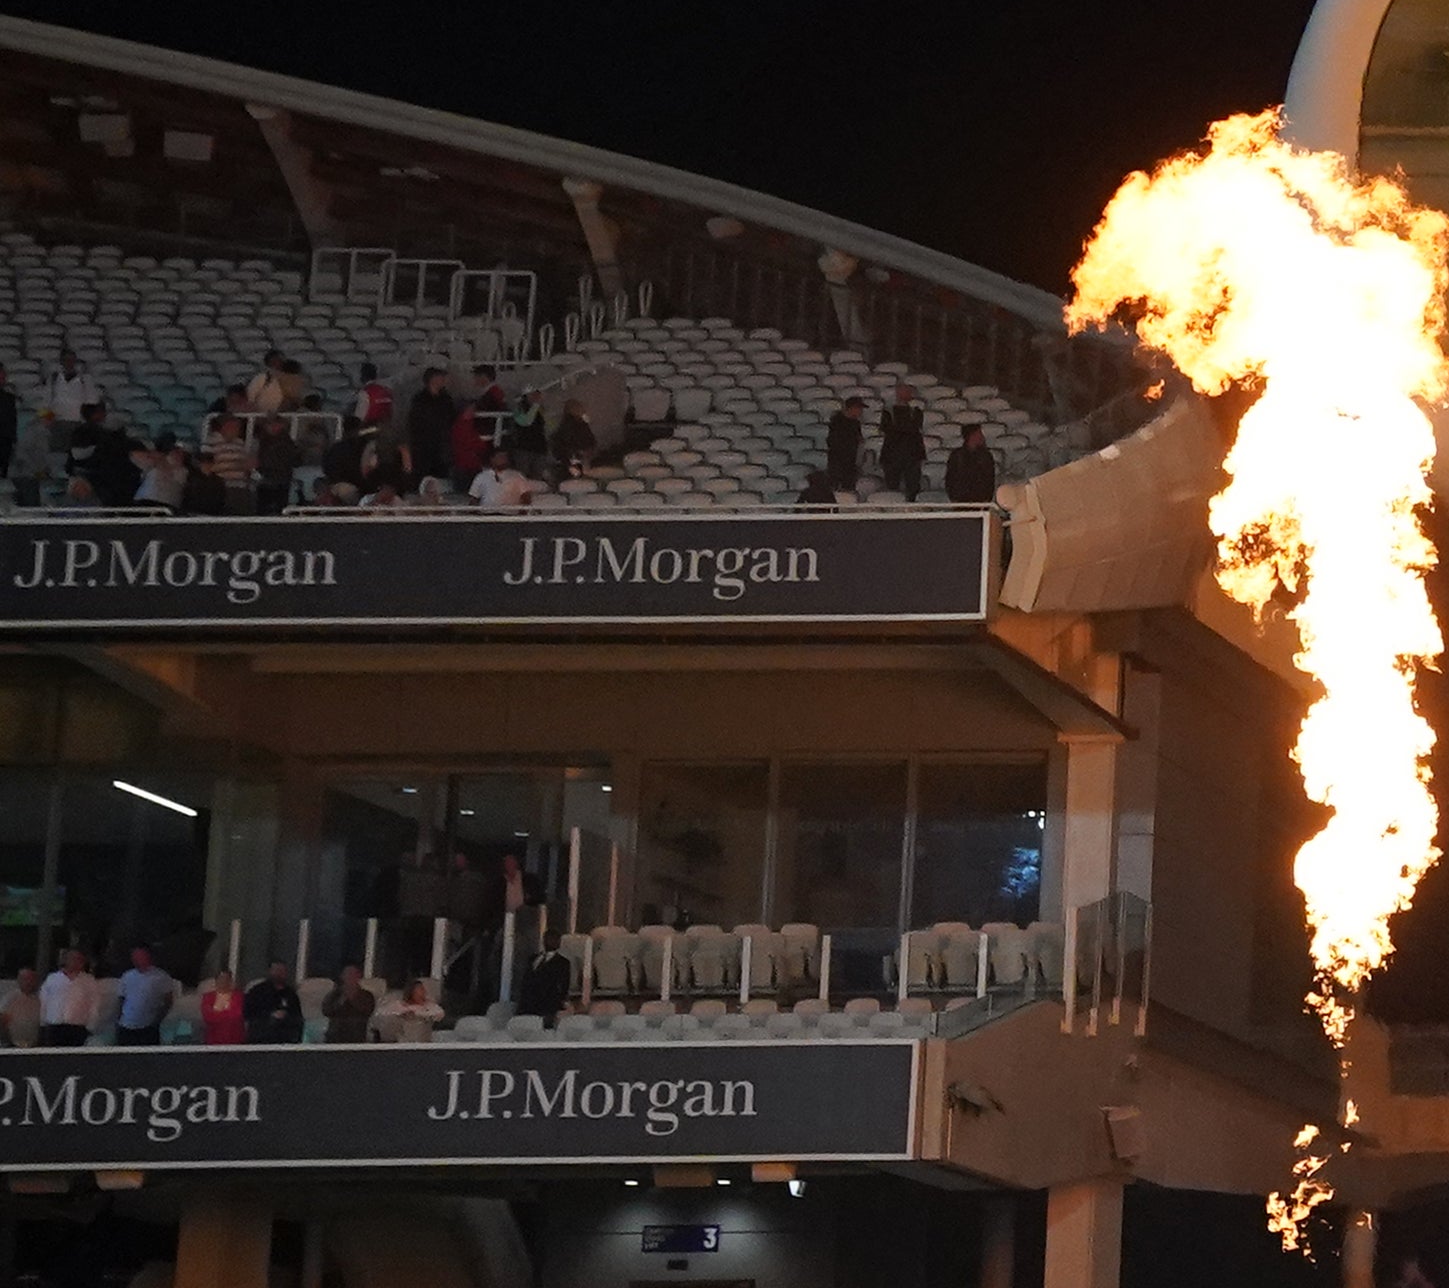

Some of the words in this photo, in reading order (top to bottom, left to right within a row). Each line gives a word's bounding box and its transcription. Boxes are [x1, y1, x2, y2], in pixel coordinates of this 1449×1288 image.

[13, 539, 337, 604] J.P.Morgan
[503, 535, 820, 600] J.P.Morgan
[427, 1069, 757, 1137] J.P.Morgan
[703, 1227, 718, 1249] 3
